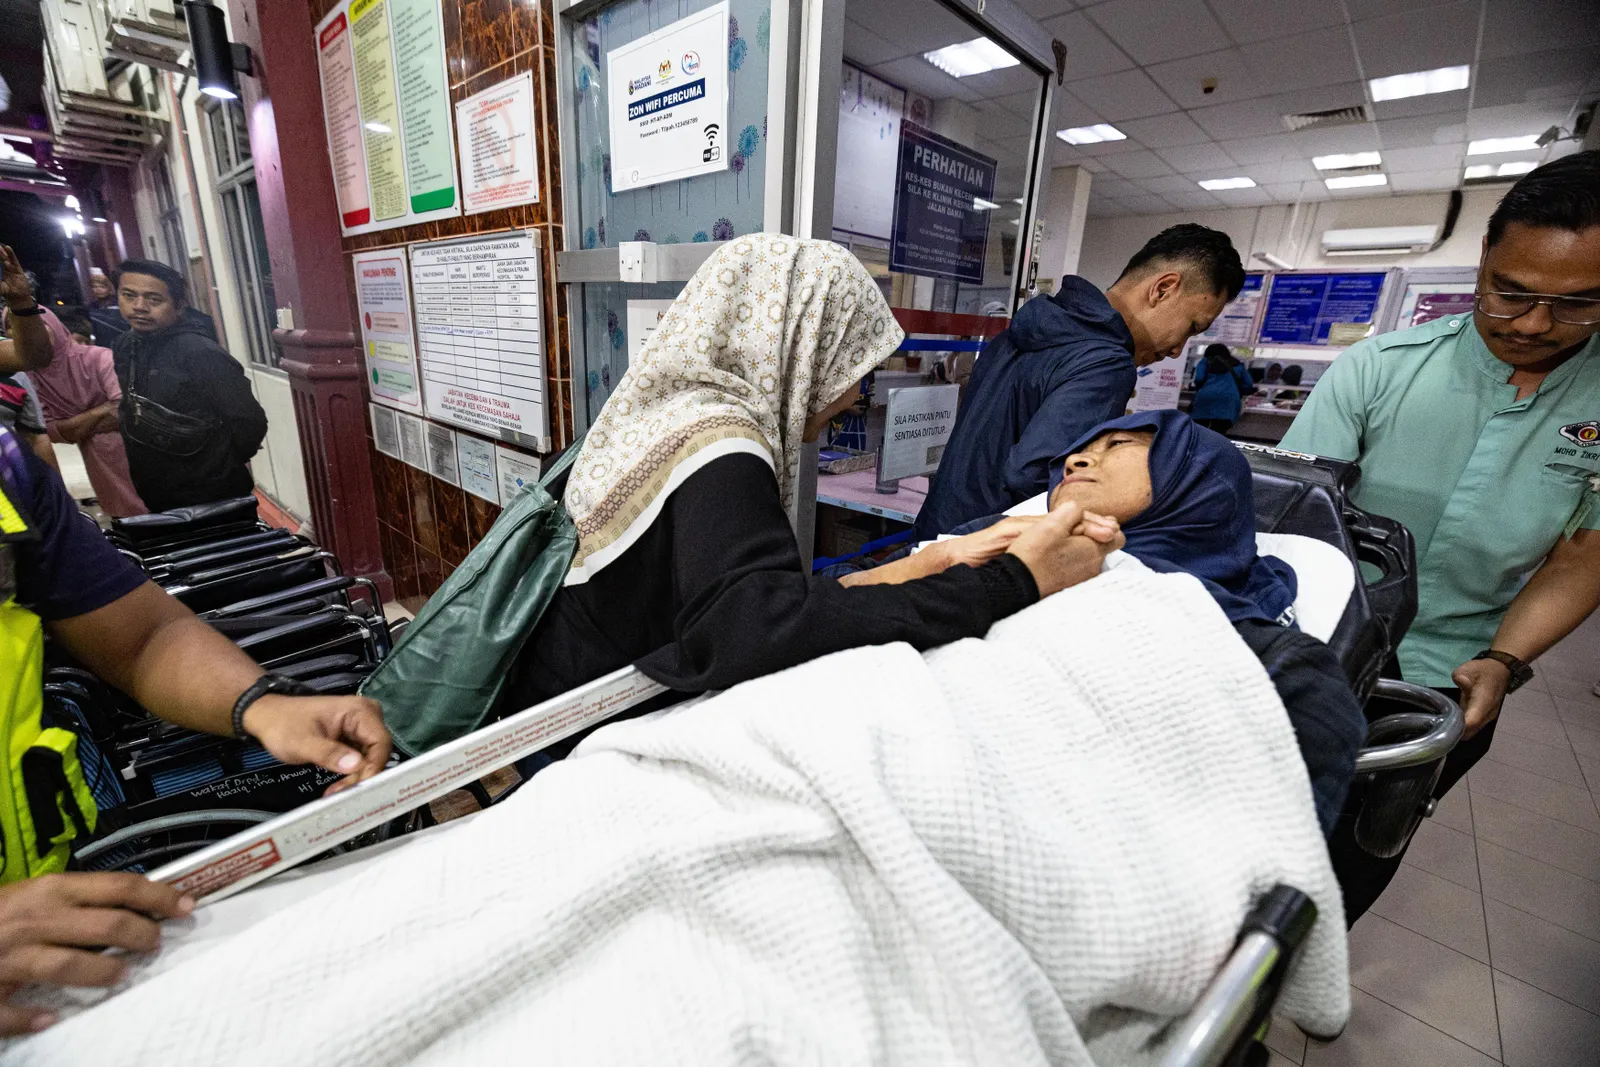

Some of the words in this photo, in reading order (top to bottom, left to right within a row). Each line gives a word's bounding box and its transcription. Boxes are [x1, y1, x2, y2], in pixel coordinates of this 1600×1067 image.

[634, 80, 651, 90] MADANI
[629, 104, 644, 118] ZON
[645, 98, 661, 111] WIFI
[663, 85, 702, 106] PERCUMA
[640, 129, 658, 138] Password
[914, 144, 984, 187] PERHATIAN
[905, 171, 932, 188] KES-KES
[933, 181, 953, 195] BUKAN
[908, 184, 921, 195] SILA
[923, 189, 931, 198] KE
[932, 191, 952, 205] KLINIK
[927, 202, 945, 214] JALAN
[464, 392, 487, 403] KECEMASAN
[492, 399, 510, 409] TRAUMA
[477, 405, 501, 416] KECEMASAN
[503, 411, 520, 421] SAHAJA
[894, 416, 906, 425] SILA
[908, 412, 934, 423] PASTIKAN
[935, 410, 952, 420] PINTU
[894, 430, 921, 441] SENTIASA
[1554, 447, 1577, 456] MOHD
[515, 718, 547, 734] authorized
[525, 726, 545, 738] weight
[298, 782, 313, 792] Hj
